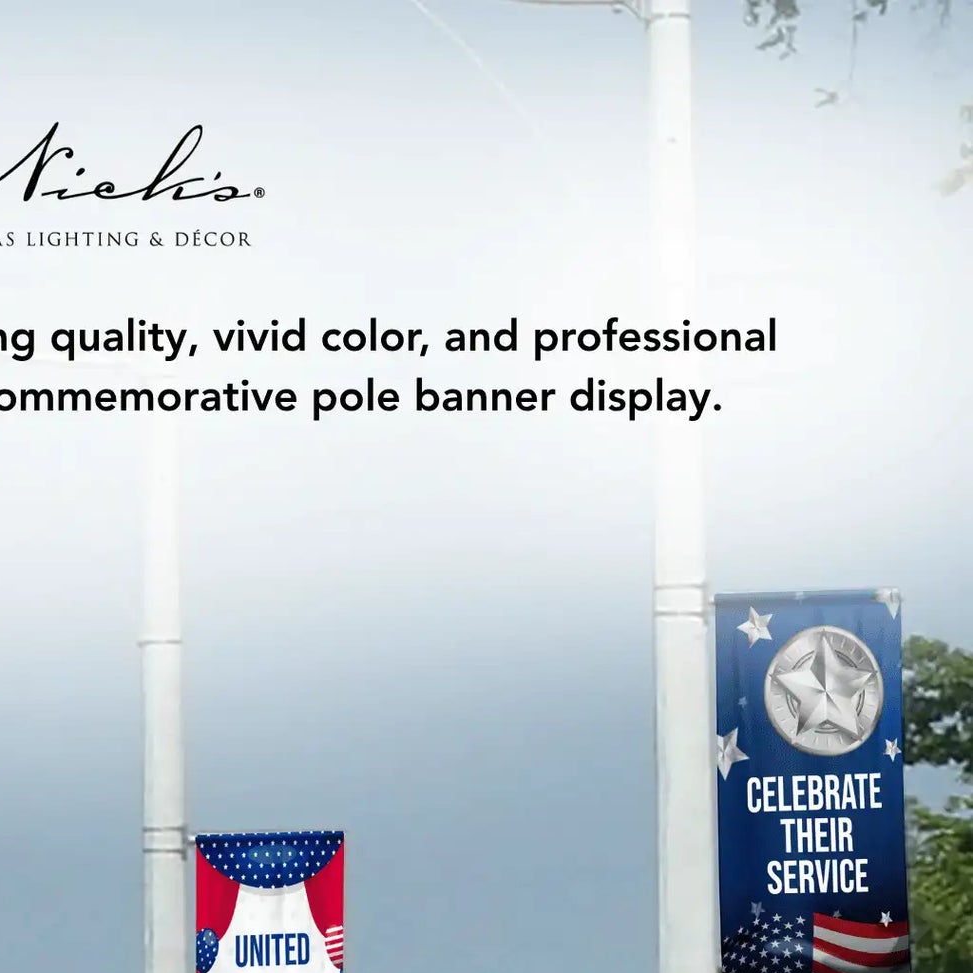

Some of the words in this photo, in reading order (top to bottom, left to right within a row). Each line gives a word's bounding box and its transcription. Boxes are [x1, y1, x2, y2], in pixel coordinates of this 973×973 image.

[746, 772, 882, 814] CELEBRATE
[779, 817, 854, 853] THEIR
[766, 858, 869, 895] SERVICE
[234, 932, 310, 968] UNITED
